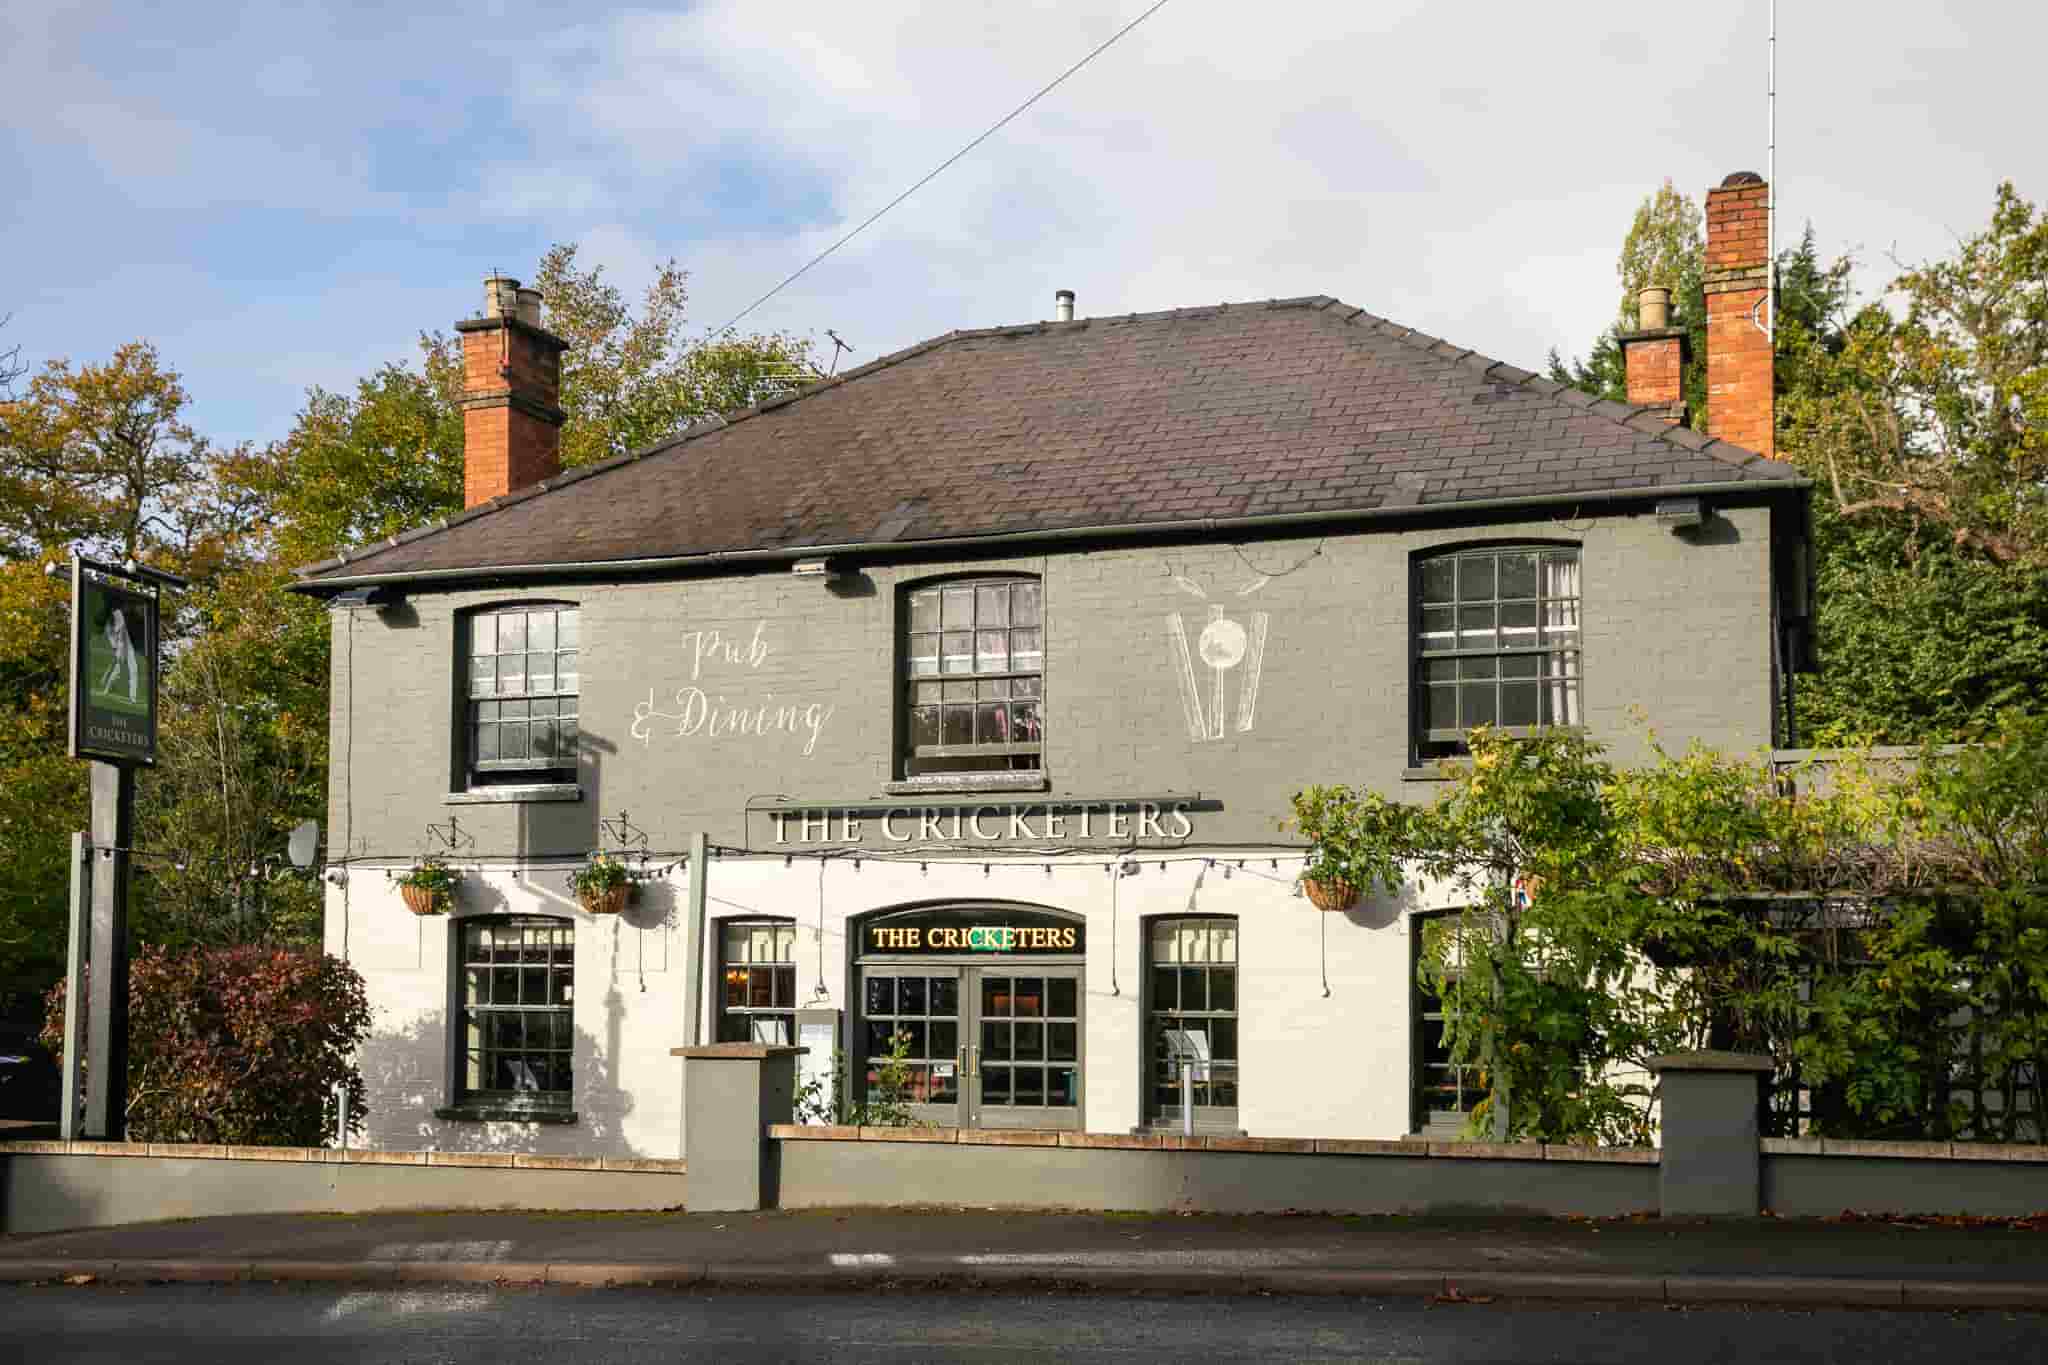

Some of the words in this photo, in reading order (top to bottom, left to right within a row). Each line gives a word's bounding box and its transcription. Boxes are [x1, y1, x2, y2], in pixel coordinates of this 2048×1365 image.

[681, 619, 769, 680] Pub
[631, 687, 658, 748] &
[675, 687, 836, 760] Dining
[774, 806, 864, 844] THE
[881, 800, 1193, 842] CRICKETERS
[872, 926, 921, 948] THE
[927, 926, 1076, 948] CRICKETERS
